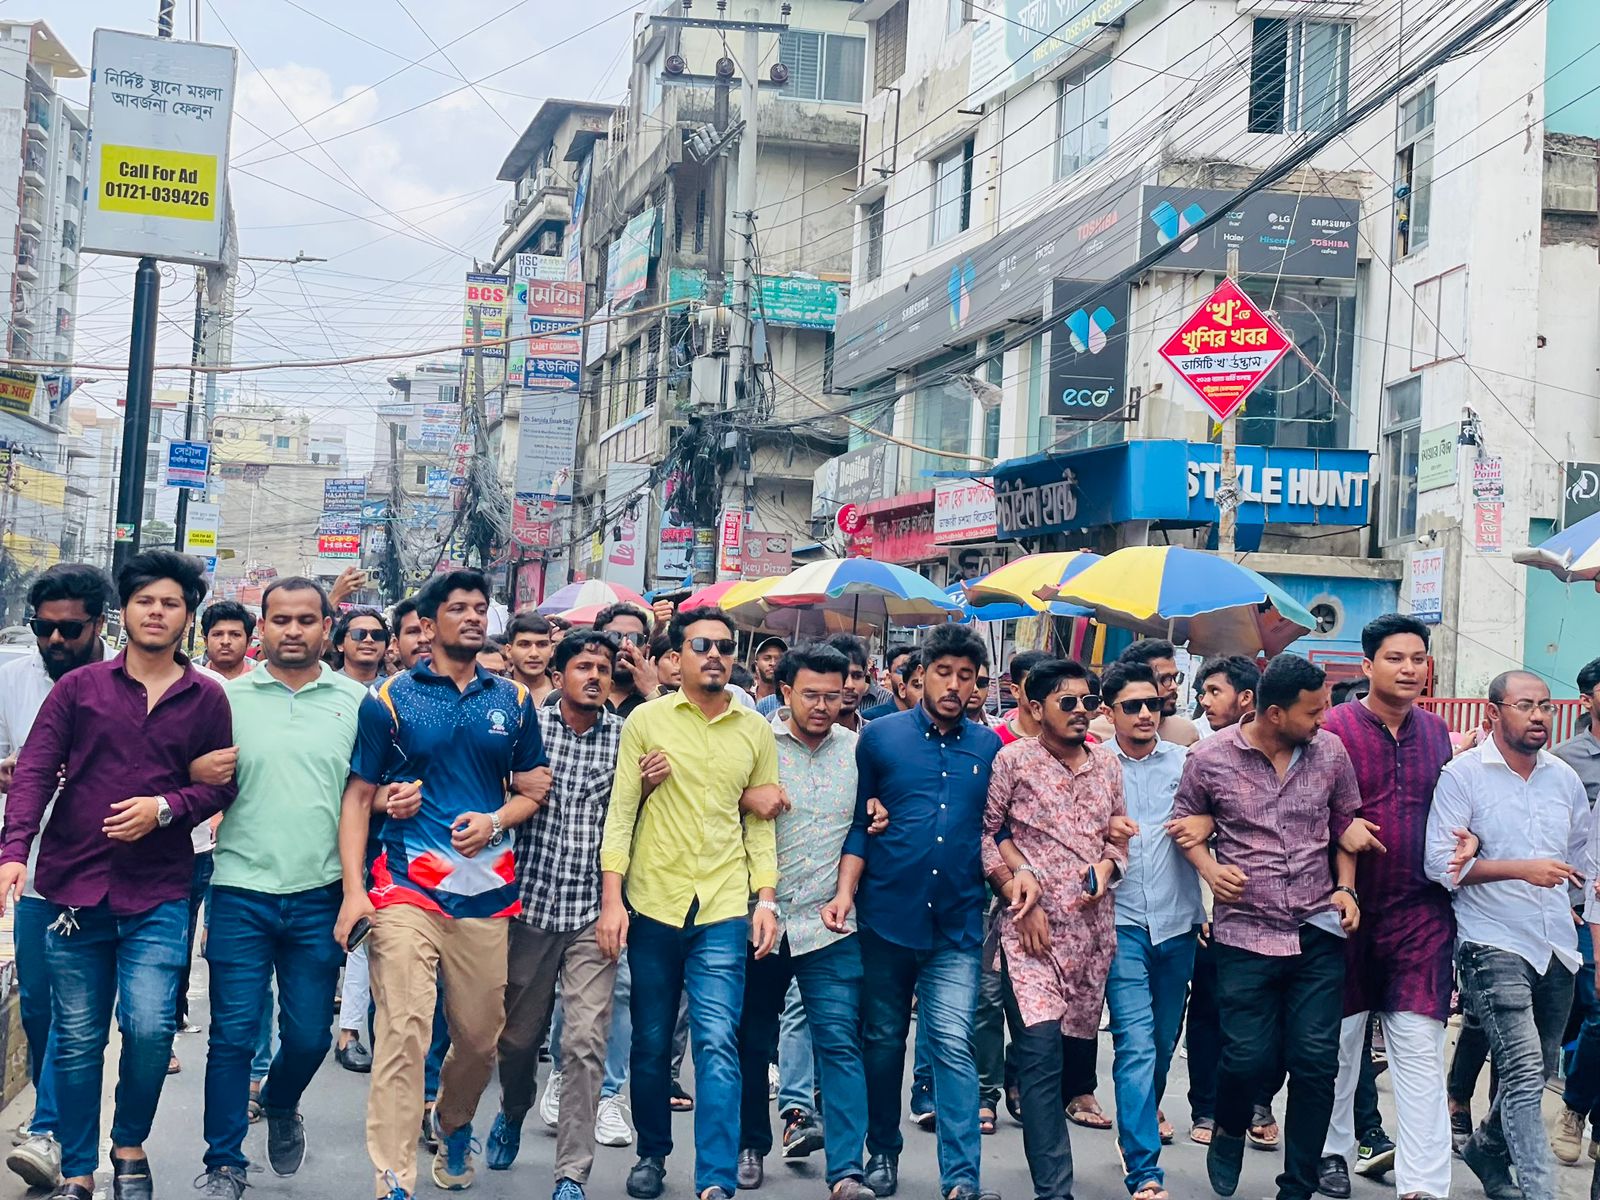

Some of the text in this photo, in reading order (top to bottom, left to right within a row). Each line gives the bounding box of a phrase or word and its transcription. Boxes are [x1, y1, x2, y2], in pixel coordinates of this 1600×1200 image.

[104, 68, 224, 102] নির্দিষ্ট স্থানে ময়লা
[111, 91, 214, 121] আবর্জনা ফেলুন
[119, 162, 198, 184] Call For Ad
[105, 181, 210, 207] 01721-039426
[1077, 210, 1120, 242] TOSHIBA
[1279, 215, 1291, 223] LG
[1311, 218, 1351, 228] SAMSUNG
[1223, 233, 1350, 249] Haier Hisense TOSHIBA
[519, 254, 538, 267] HSC
[519, 266, 538, 277] ICT
[467, 287, 504, 302] BCS
[1181, 326, 1269, 354] খুশির খবর
[1181, 356, 1213, 370] ভার্সিটি
[1474, 470, 1501, 479] Point
[1287, 467, 1369, 508] HUNT
